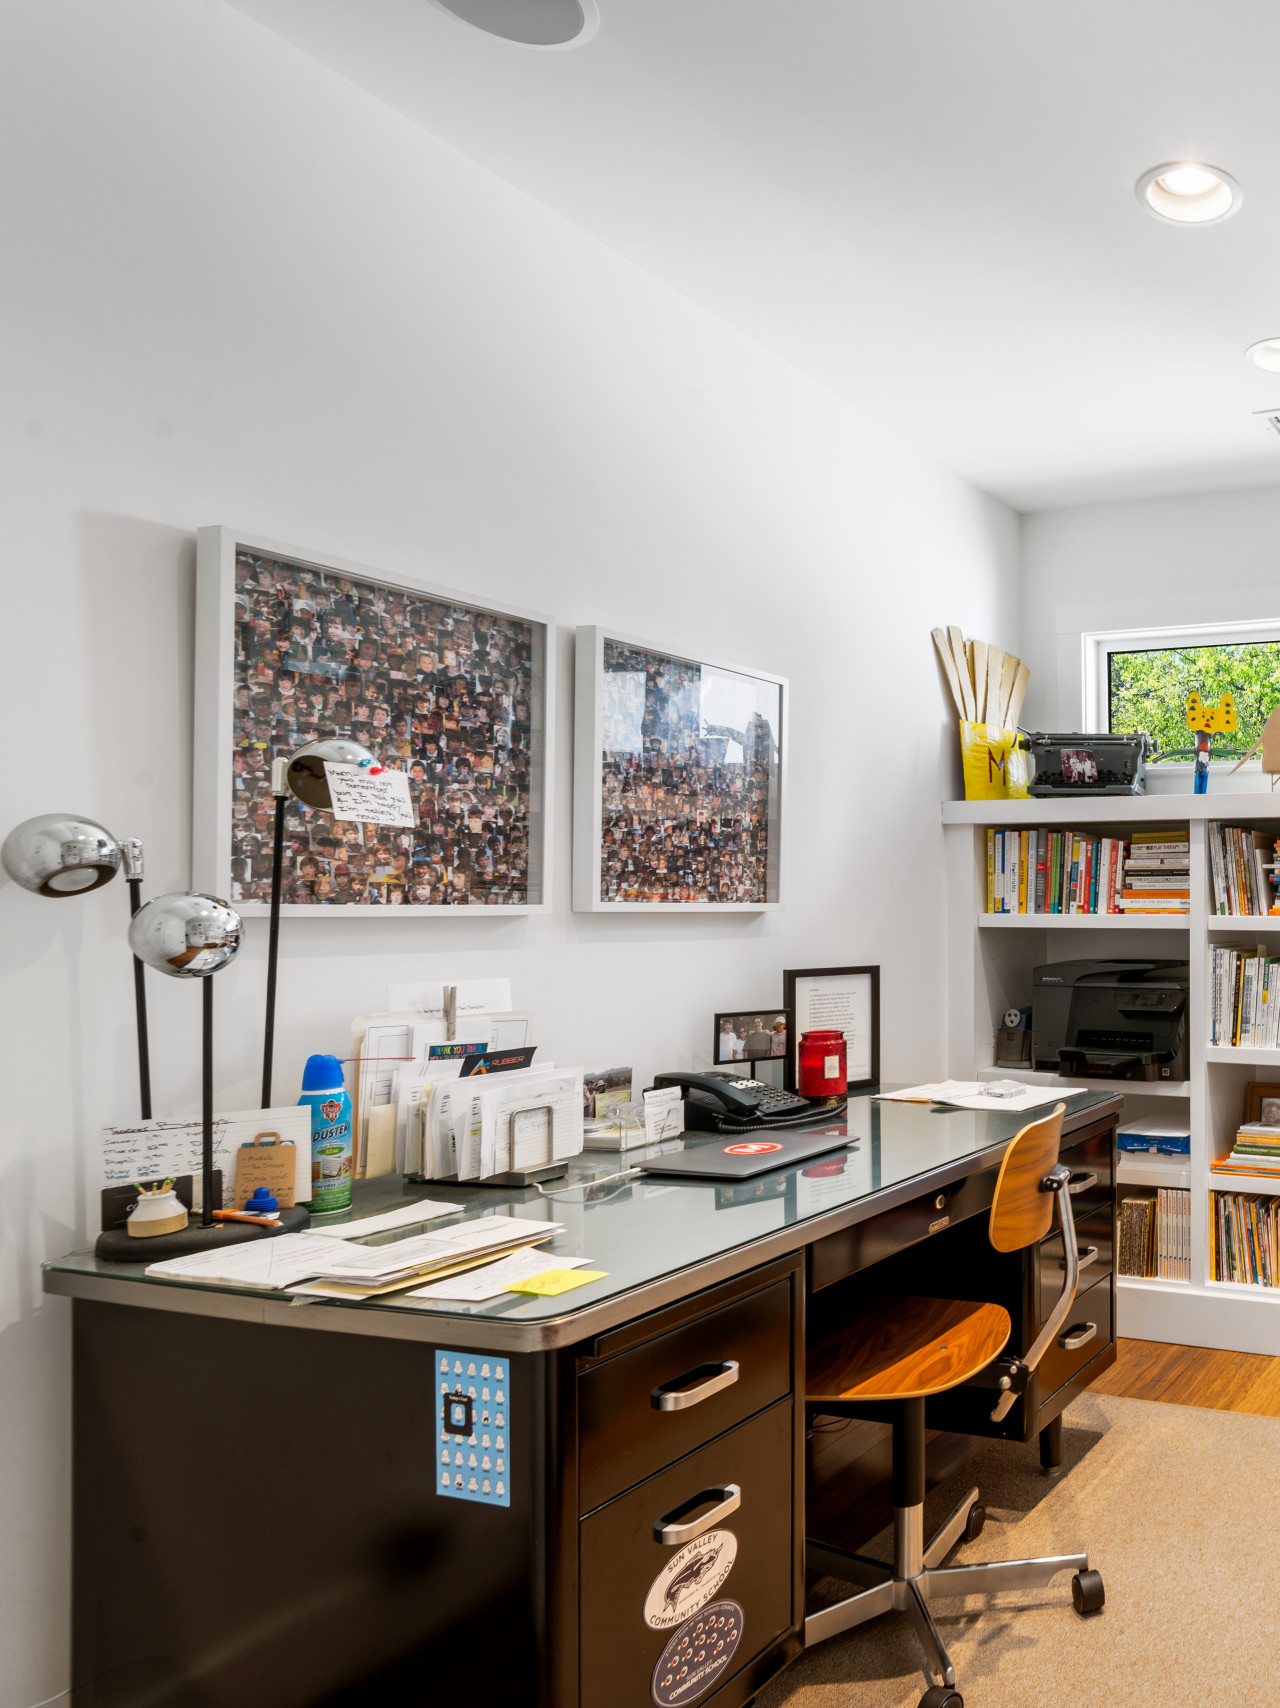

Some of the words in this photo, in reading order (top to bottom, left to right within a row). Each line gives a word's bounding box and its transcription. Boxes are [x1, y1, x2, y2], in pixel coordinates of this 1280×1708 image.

[453, 1046, 465, 1054] YOU
[491, 1056, 524, 1066] RUBBER
[312, 1122, 349, 1142] DUSTER
[668, 1553, 685, 1573] SUN
[688, 1533, 718, 1554] VALLEY
[650, 1601, 700, 1627] COMMUNITY
[703, 1558, 734, 1602] SCHOOL
[669, 1671, 704, 1700] COMMUNITY
[705, 1654, 727, 1675] SCHOOL
